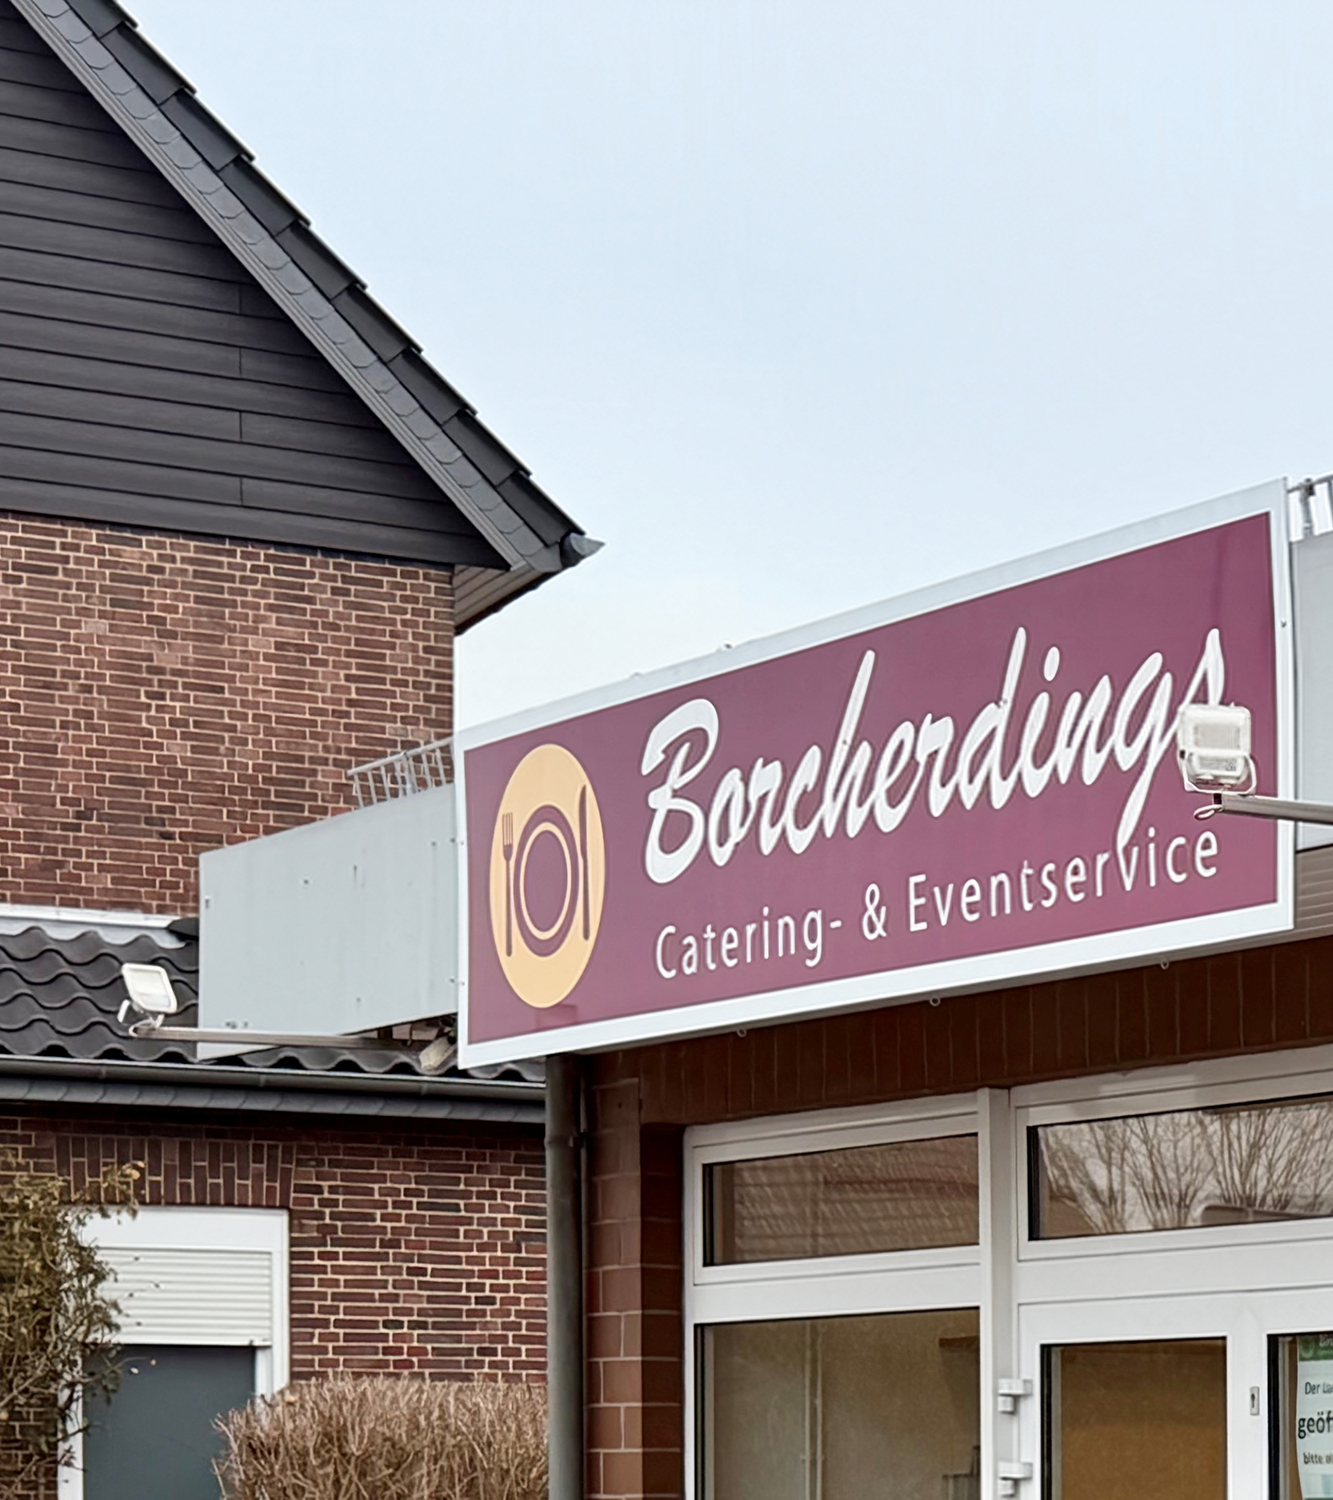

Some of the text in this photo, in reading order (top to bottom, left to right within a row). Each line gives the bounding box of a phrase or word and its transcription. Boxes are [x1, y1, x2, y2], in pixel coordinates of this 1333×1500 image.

[641, 626, 1225, 884] Borcherdings
[656, 826, 1218, 979] Catering- & Eventservice
[1305, 1381, 1320, 1395] Der
[1303, 1452, 1323, 1465] bitte
